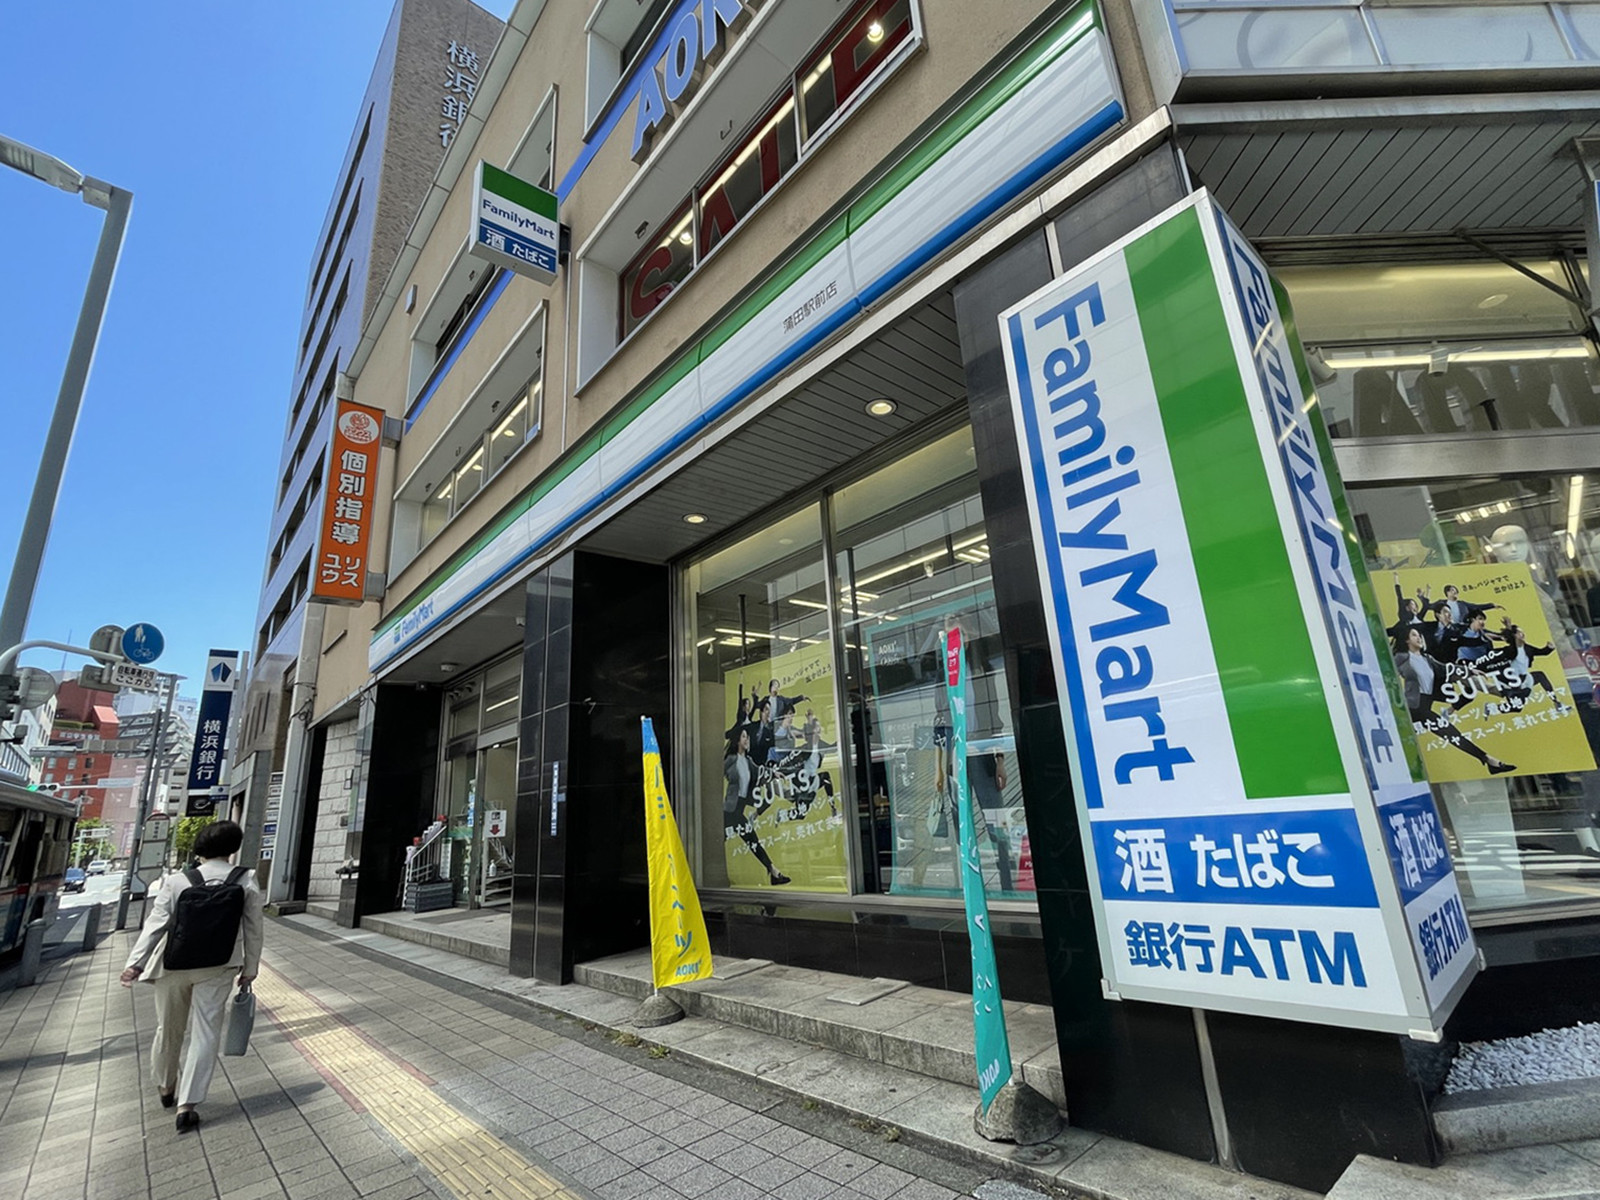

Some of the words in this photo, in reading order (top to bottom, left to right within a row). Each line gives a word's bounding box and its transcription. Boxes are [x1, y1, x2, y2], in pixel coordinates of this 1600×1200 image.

[482, 199, 556, 241] FamilyMart
[485, 229, 505, 252] 酒
[511, 242, 550, 269] たばこ
[783, 280, 837, 334] 蒲田駅前店
[331, 450, 368, 546] 個別指導
[1233, 238, 1394, 764] FamilyMart
[1031, 281, 1194, 786] FamilyMart
[116, 675, 152, 688] ここから
[1440, 667, 1522, 704] SUITS
[195, 719, 222, 781] 横浜銀行
[752, 769, 810, 808] SUITS
[1113, 829, 1168, 893] 酒
[1190, 831, 1335, 889] たばこ
[1388, 813, 1422, 889] 酒
[1410, 811, 1445, 871] たばこ
[1124, 921, 1368, 989] 銀行ATM
[1418, 893, 1469, 981] 銀行ATM
